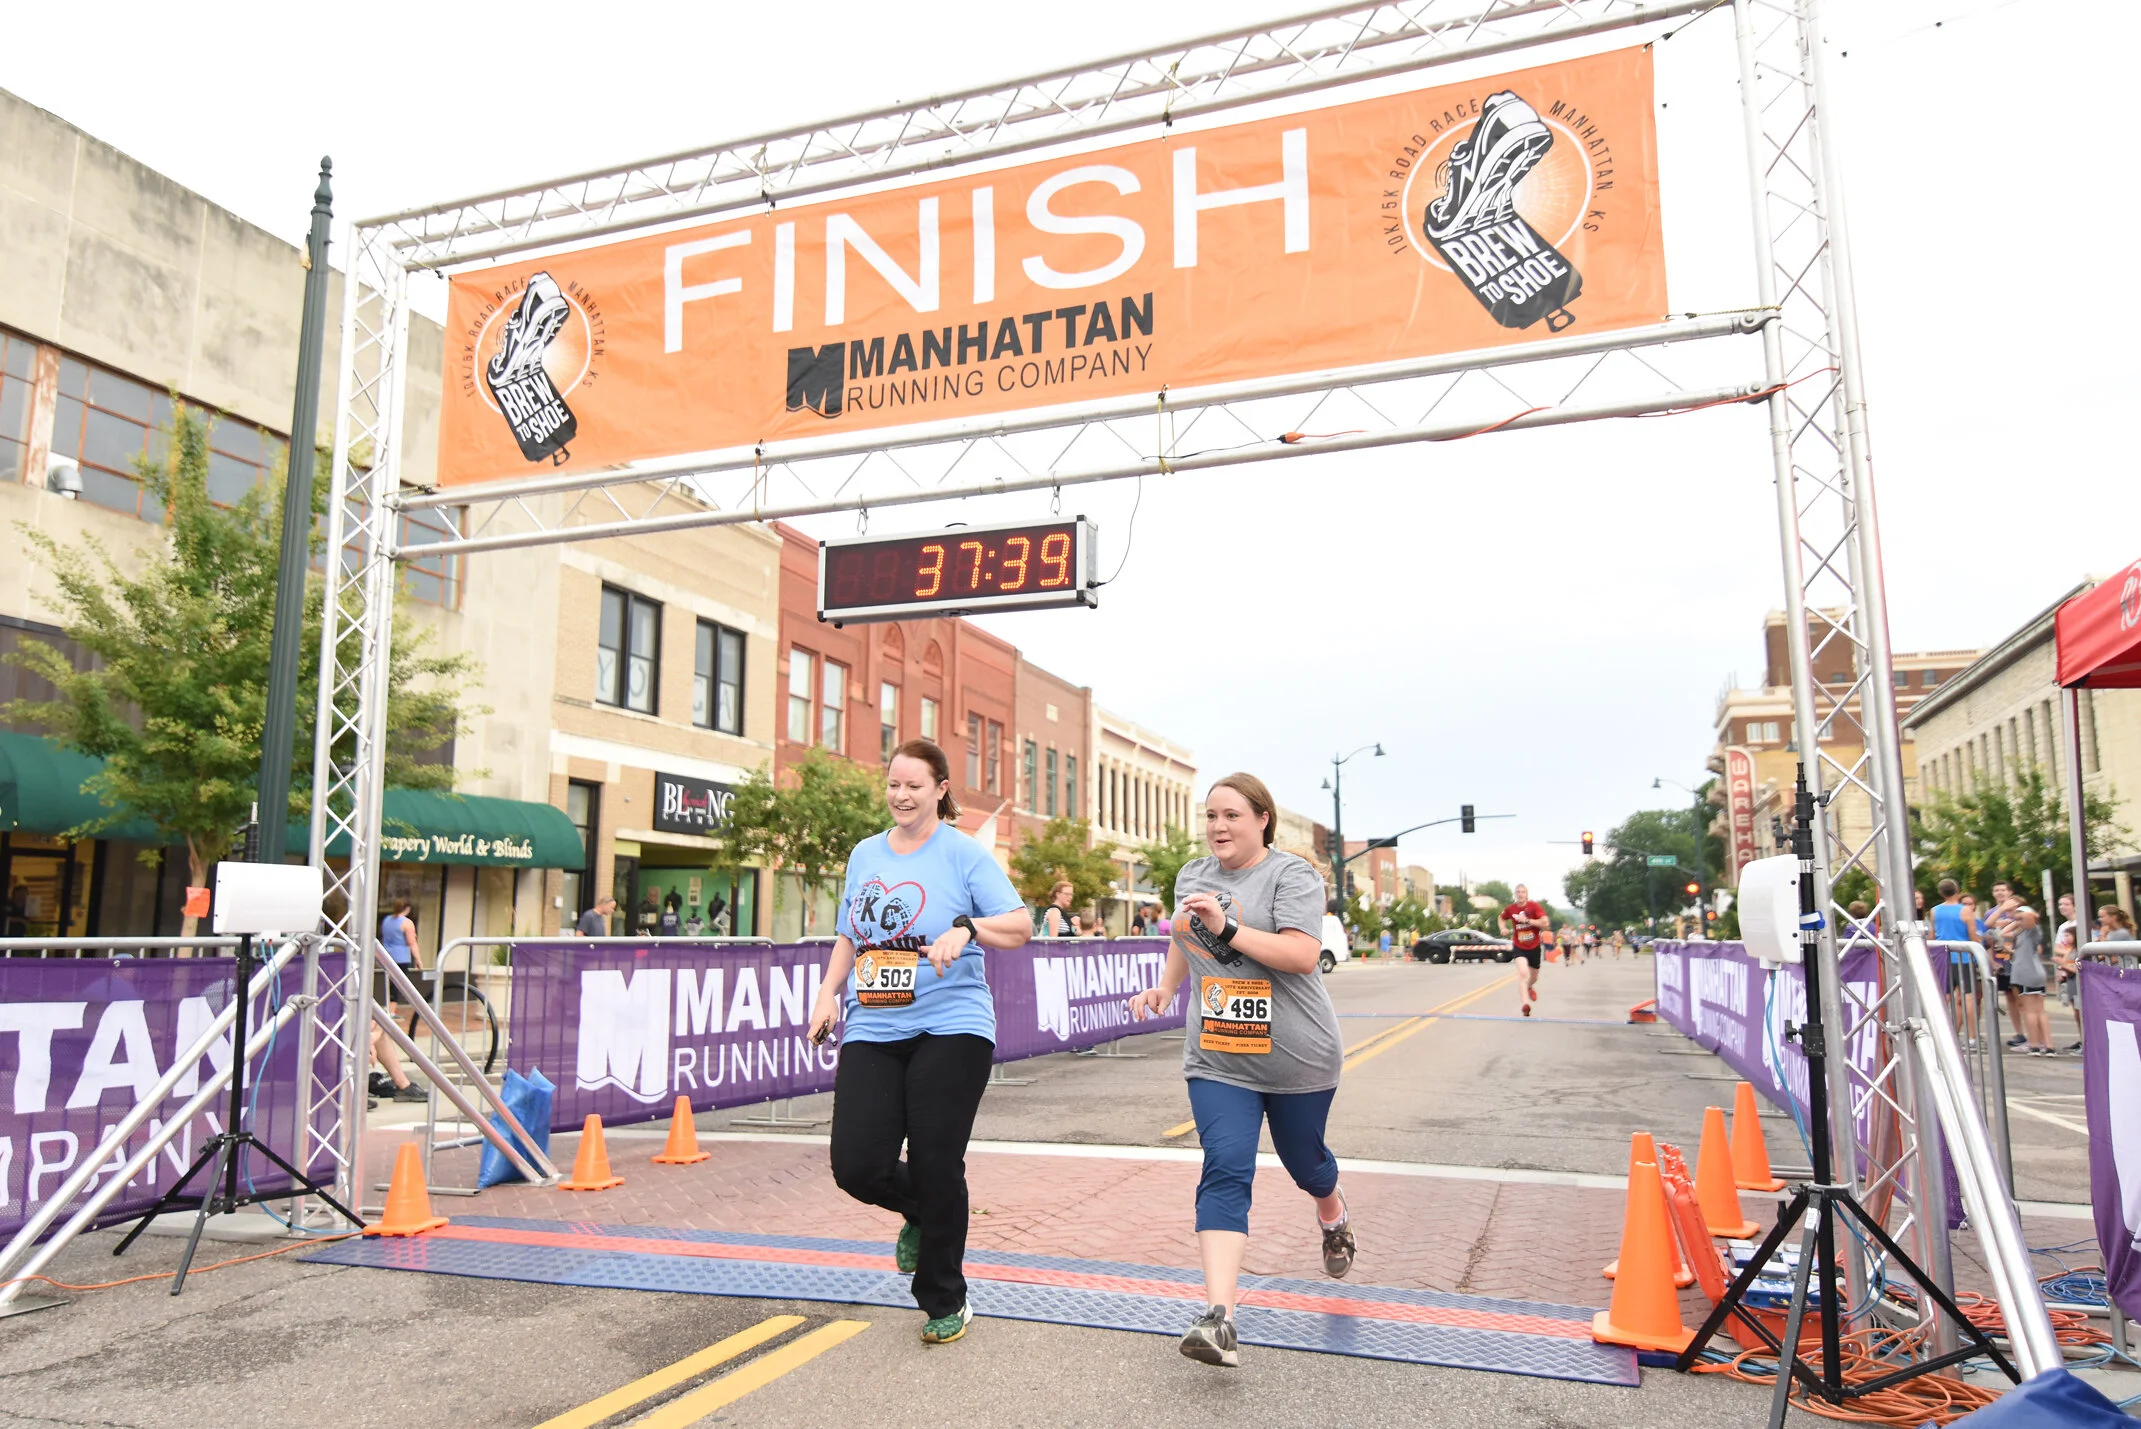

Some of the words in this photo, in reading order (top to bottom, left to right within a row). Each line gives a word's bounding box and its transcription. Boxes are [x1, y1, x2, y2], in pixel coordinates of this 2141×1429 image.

[1430, 98, 1480, 132] RACE
[1390, 134, 1427, 180] ROAD
[664, 127, 1310, 354] FINISH
[1382, 189, 1408, 255] 10K/5K
[1582, 208, 1607, 233] KS
[1440, 218, 1542, 287] BREW
[1479, 281, 1504, 305] TO
[1501, 250, 1568, 305] SHOE
[468, 303, 495, 338] ROAD
[495, 276, 526, 303] RACE
[849, 291, 1155, 380] MANHATTAN
[495, 372, 555, 428] BREW
[582, 371, 600, 389] KS
[847, 371, 985, 414] RUNNING
[996, 343, 1156, 392] COMPANY
[516, 425, 532, 442] TO
[528, 399, 570, 444] SHOE
[1731, 756, 1754, 862] WAREHA
[432, 833, 475, 856] World
[475, 838, 490, 857] &
[491, 837, 533, 859] Blinds
[880, 968, 912, 988] 503
[1065, 952, 1169, 1000] MANHATT
[1069, 998, 1130, 1035] RUNNING
[1214, 1020, 1268, 1031] MANHATTAN
[1231, 998, 1267, 1019] 496
[674, 1032, 838, 1092] RUNNING
